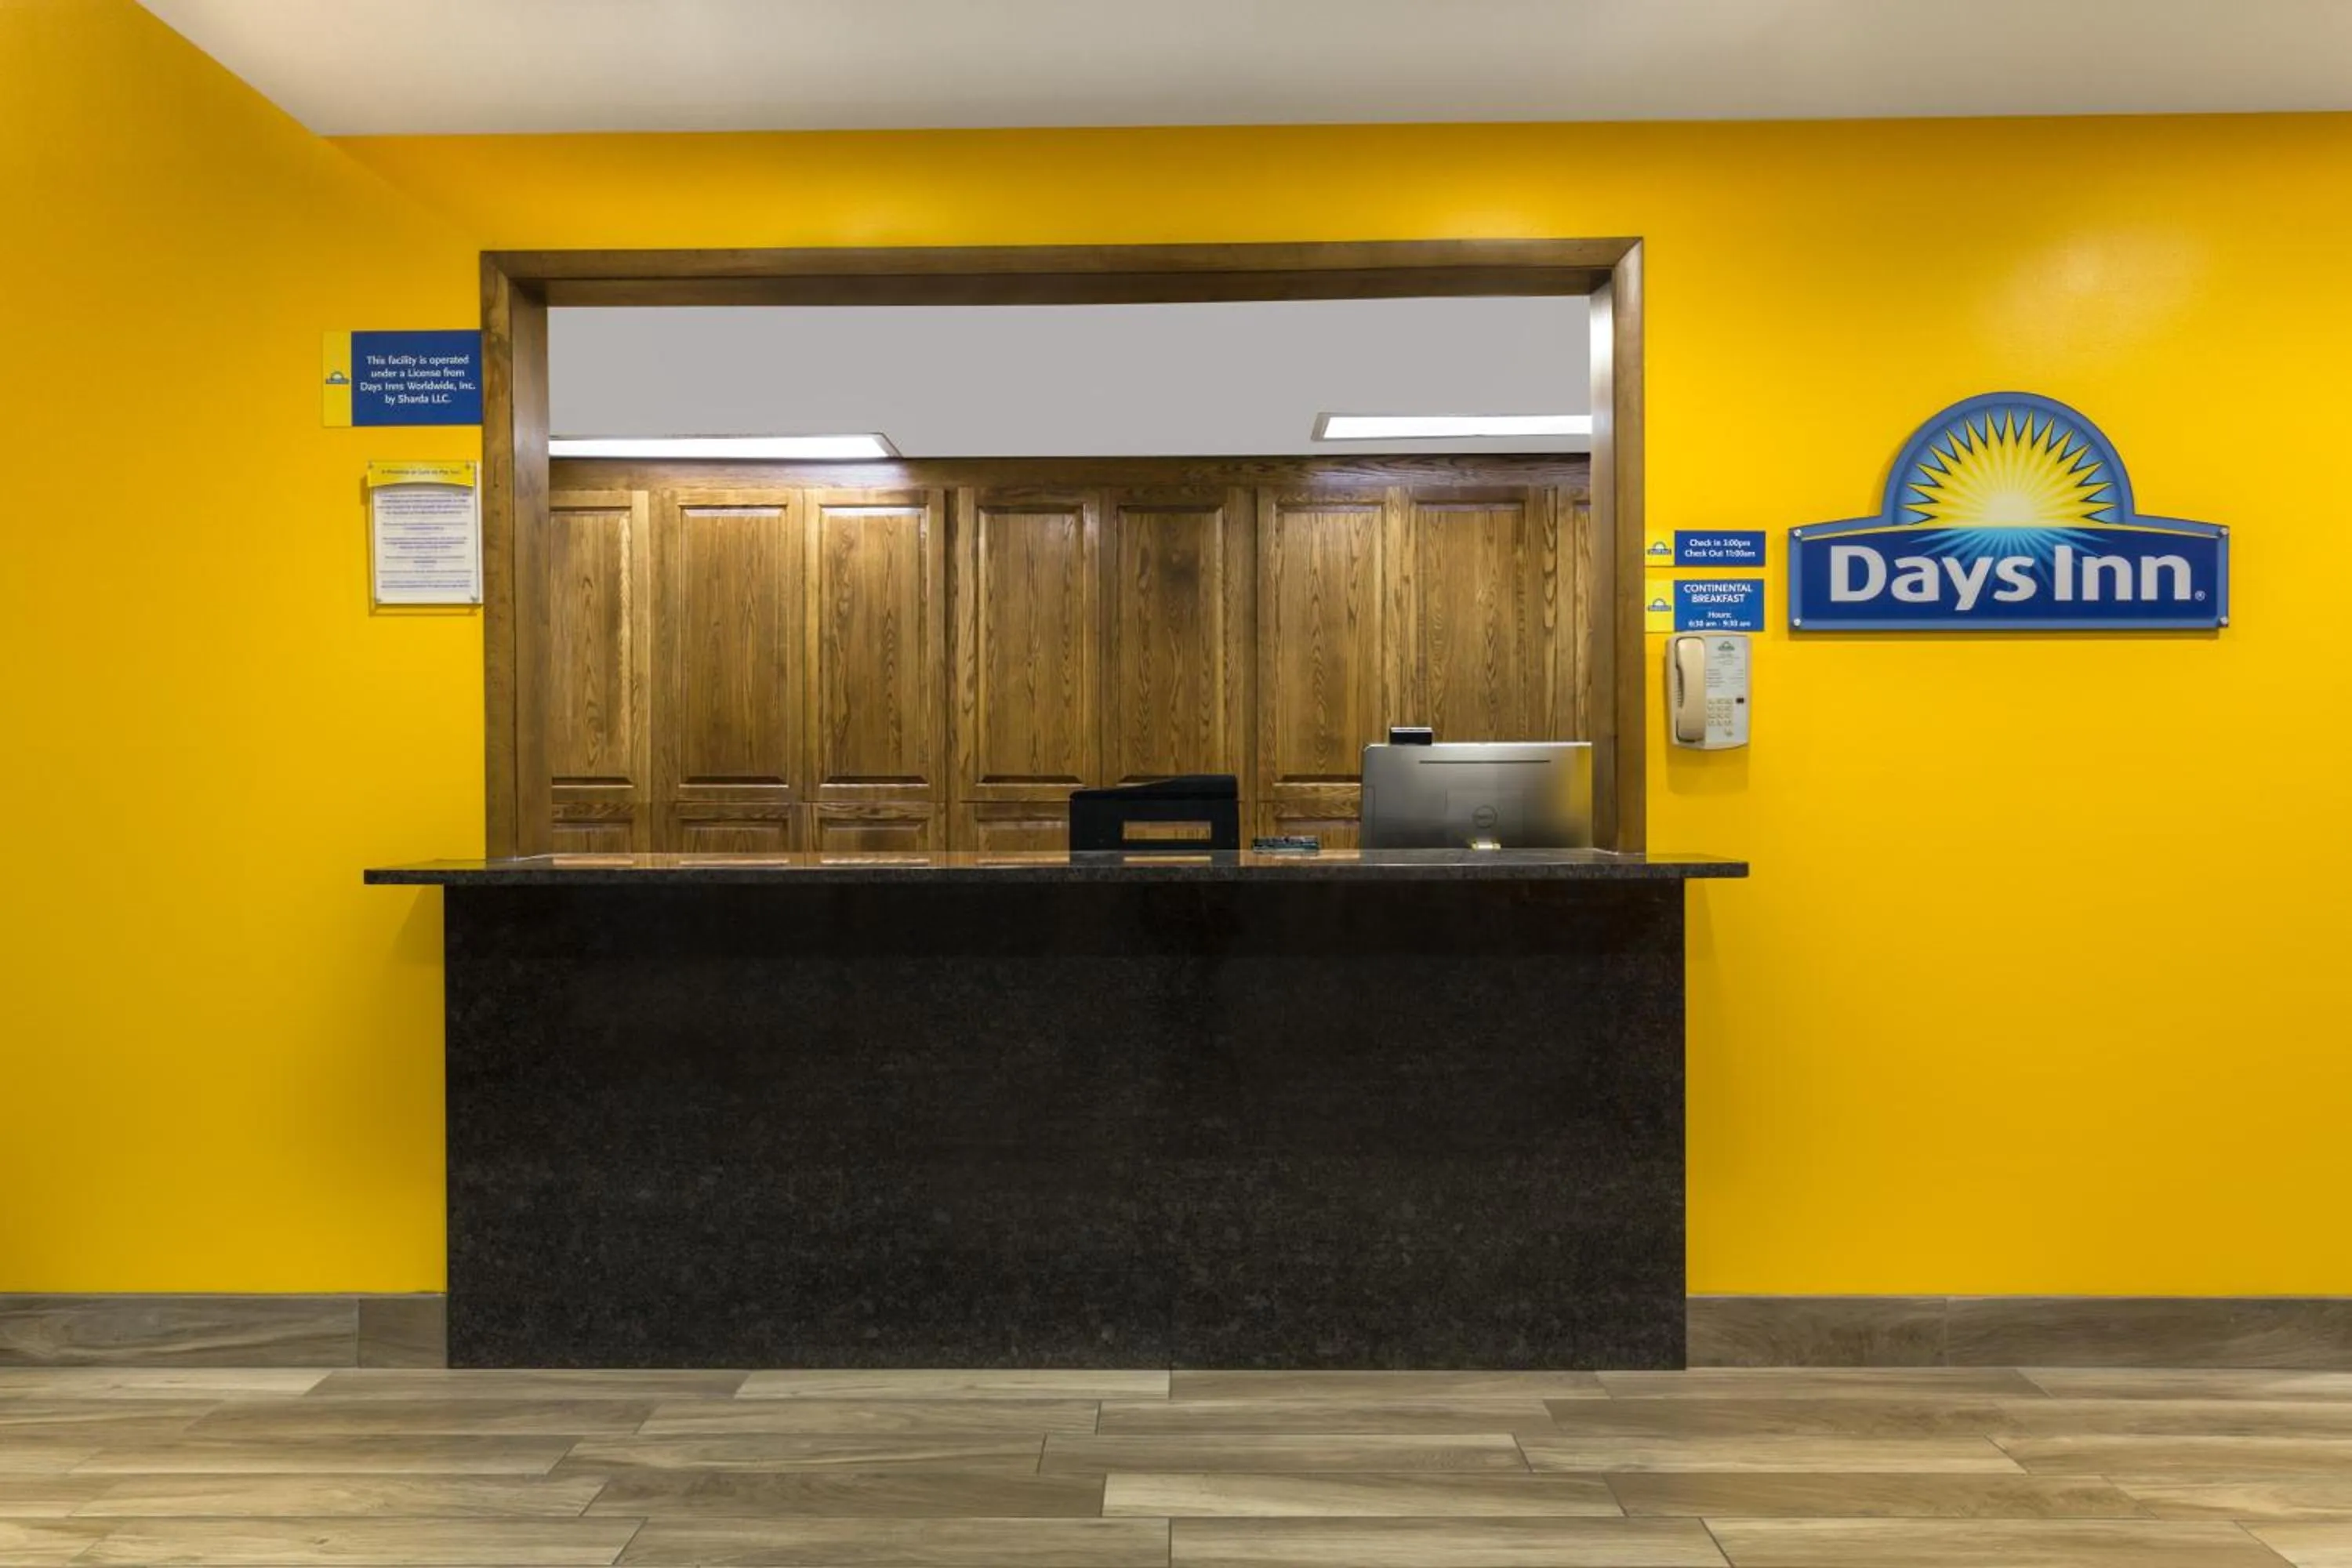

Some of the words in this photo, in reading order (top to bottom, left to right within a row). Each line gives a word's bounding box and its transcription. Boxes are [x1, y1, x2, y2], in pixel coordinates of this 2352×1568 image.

[367, 356, 386, 365] This
[388, 355, 416, 367] facility
[419, 356, 427, 365] is
[429, 354, 470, 367] operated
[371, 368, 397, 377] under
[408, 368, 441, 377] License
[443, 368, 465, 377] from
[360, 382, 382, 394] Days
[407, 381, 457, 392] Worldwide,
[459, 381, 476, 390] Inc.
[385, 395, 396, 406] by
[397, 394, 429, 404] Sharda
[1830, 546, 2038, 612] Days
[2054, 545, 2192, 601] Inn
[1683, 583, 1752, 593] CONTINENTAL
[1691, 593, 1745, 603] BREAKFAST
